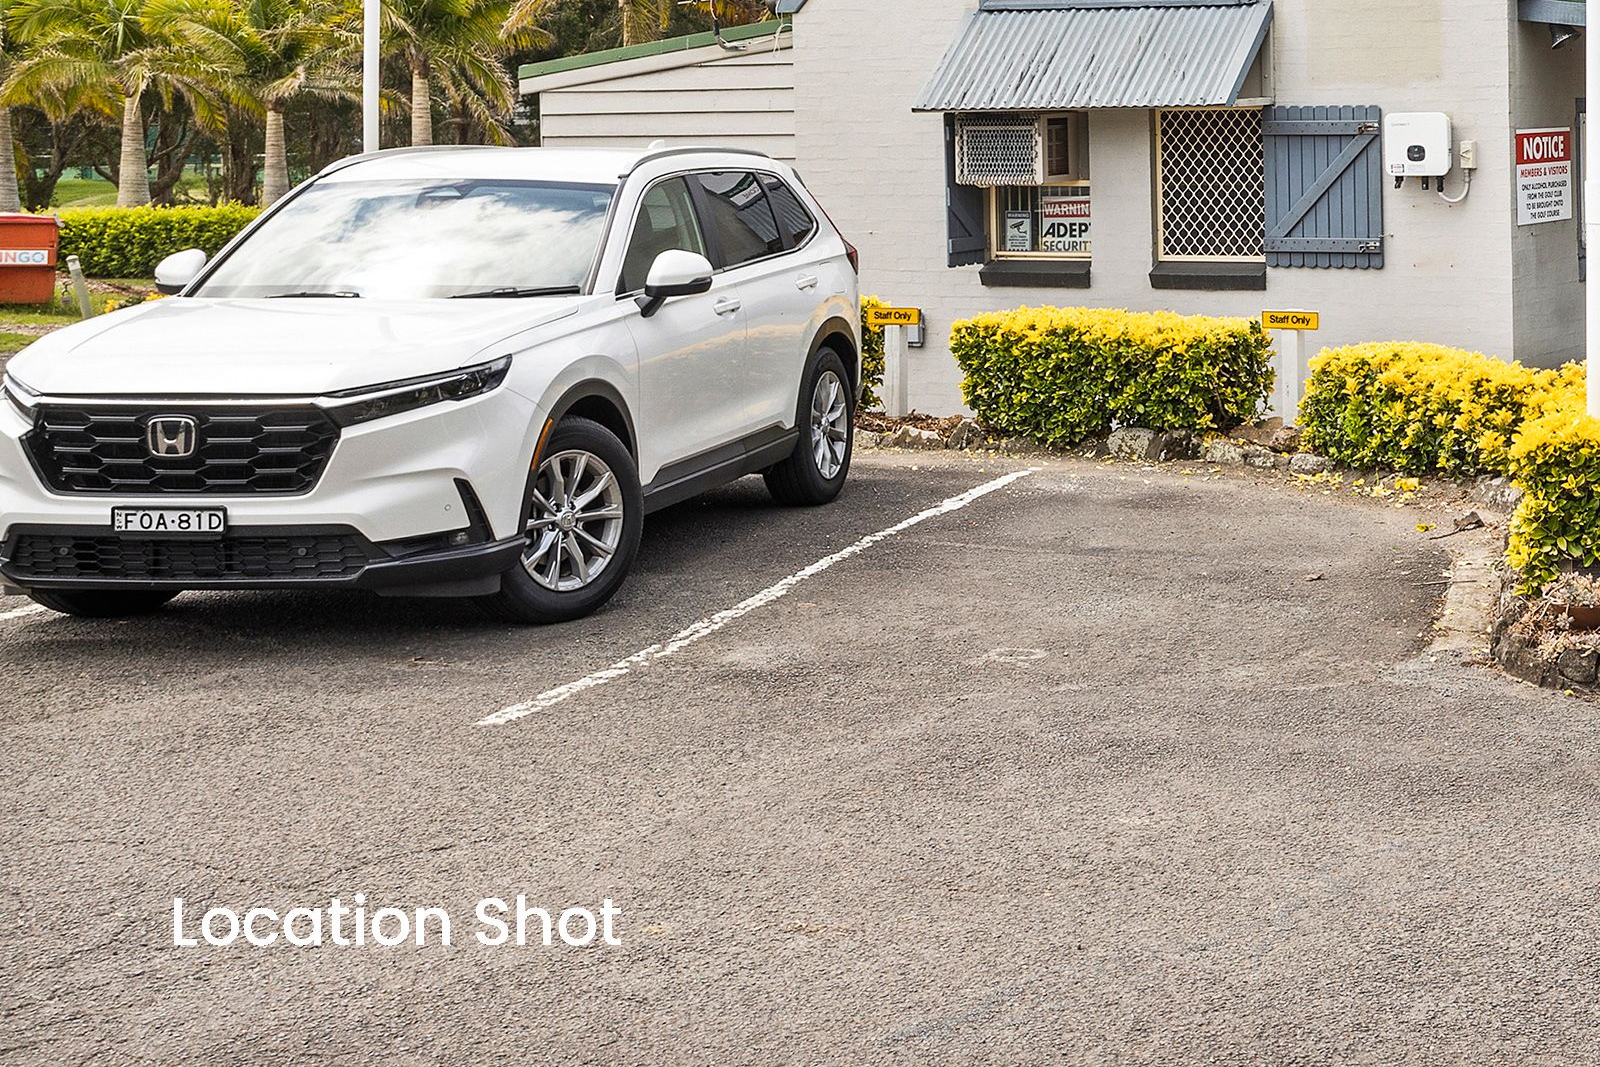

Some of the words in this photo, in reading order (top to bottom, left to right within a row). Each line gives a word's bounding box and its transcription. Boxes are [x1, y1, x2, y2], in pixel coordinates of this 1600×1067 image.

[1523, 135, 1564, 160] NOTICE
[1520, 167, 1542, 178] MEMBERS
[1543, 166, 1547, 176] &
[1548, 165, 1568, 176] VISITORS
[1521, 183, 1531, 191] ONLY
[1532, 182, 1547, 190] ALCOHOL
[1548, 180, 1567, 188] PURCHASED
[1044, 202, 1090, 215] WARNIN
[1526, 202, 1531, 210] TO
[1537, 201, 1553, 209] BROUGHT
[1554, 199, 1563, 207] ONTO
[1547, 209, 1560, 217] COURSE
[1043, 222, 1091, 238] ADEP
[1043, 240, 1091, 251] SECURIT
[873, 311, 892, 320] Staff
[894, 311, 911, 321] Only
[1269, 314, 1289, 323] Staff
[1291, 315, 1311, 326] Only
